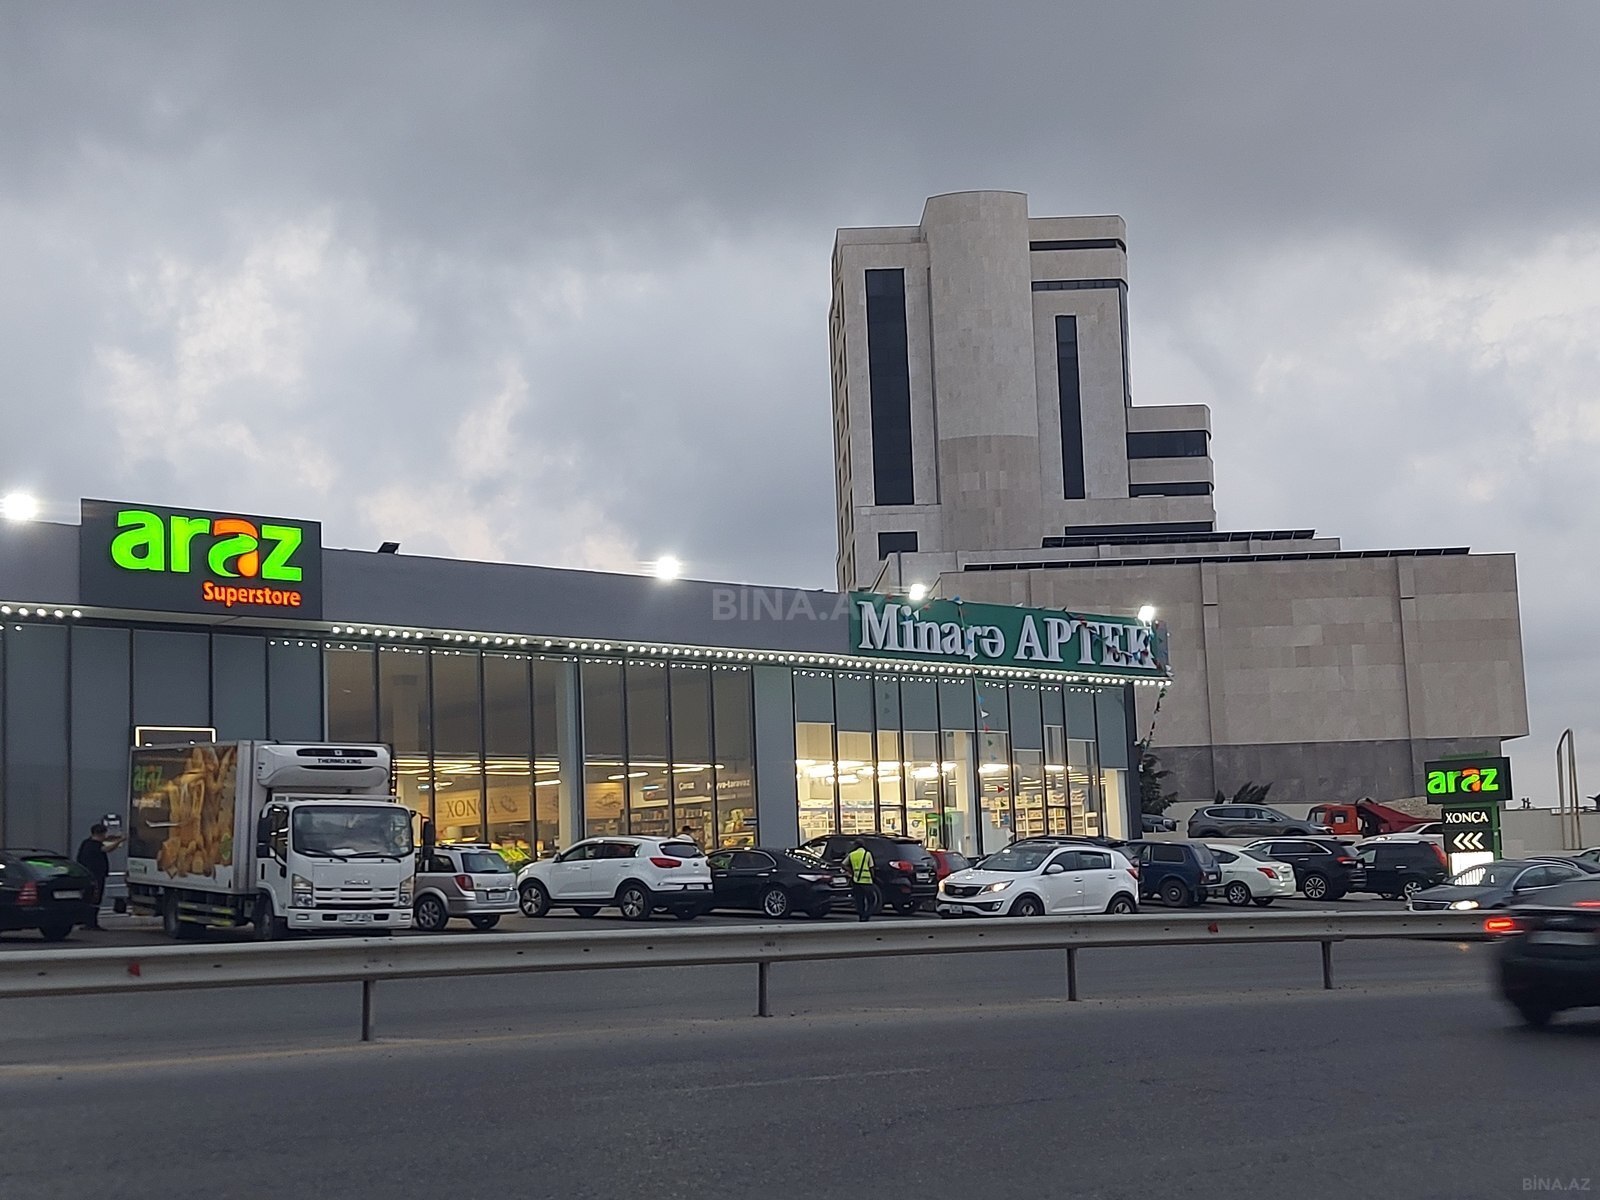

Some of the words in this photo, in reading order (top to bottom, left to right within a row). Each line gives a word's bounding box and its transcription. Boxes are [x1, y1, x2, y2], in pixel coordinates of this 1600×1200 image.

[111, 510, 303, 582] araz
[202, 580, 301, 608] Superstore
[857, 600, 1006, 660] Minarə
[1013, 614, 1158, 670] APTEK
[1427, 768, 1499, 796] araz
